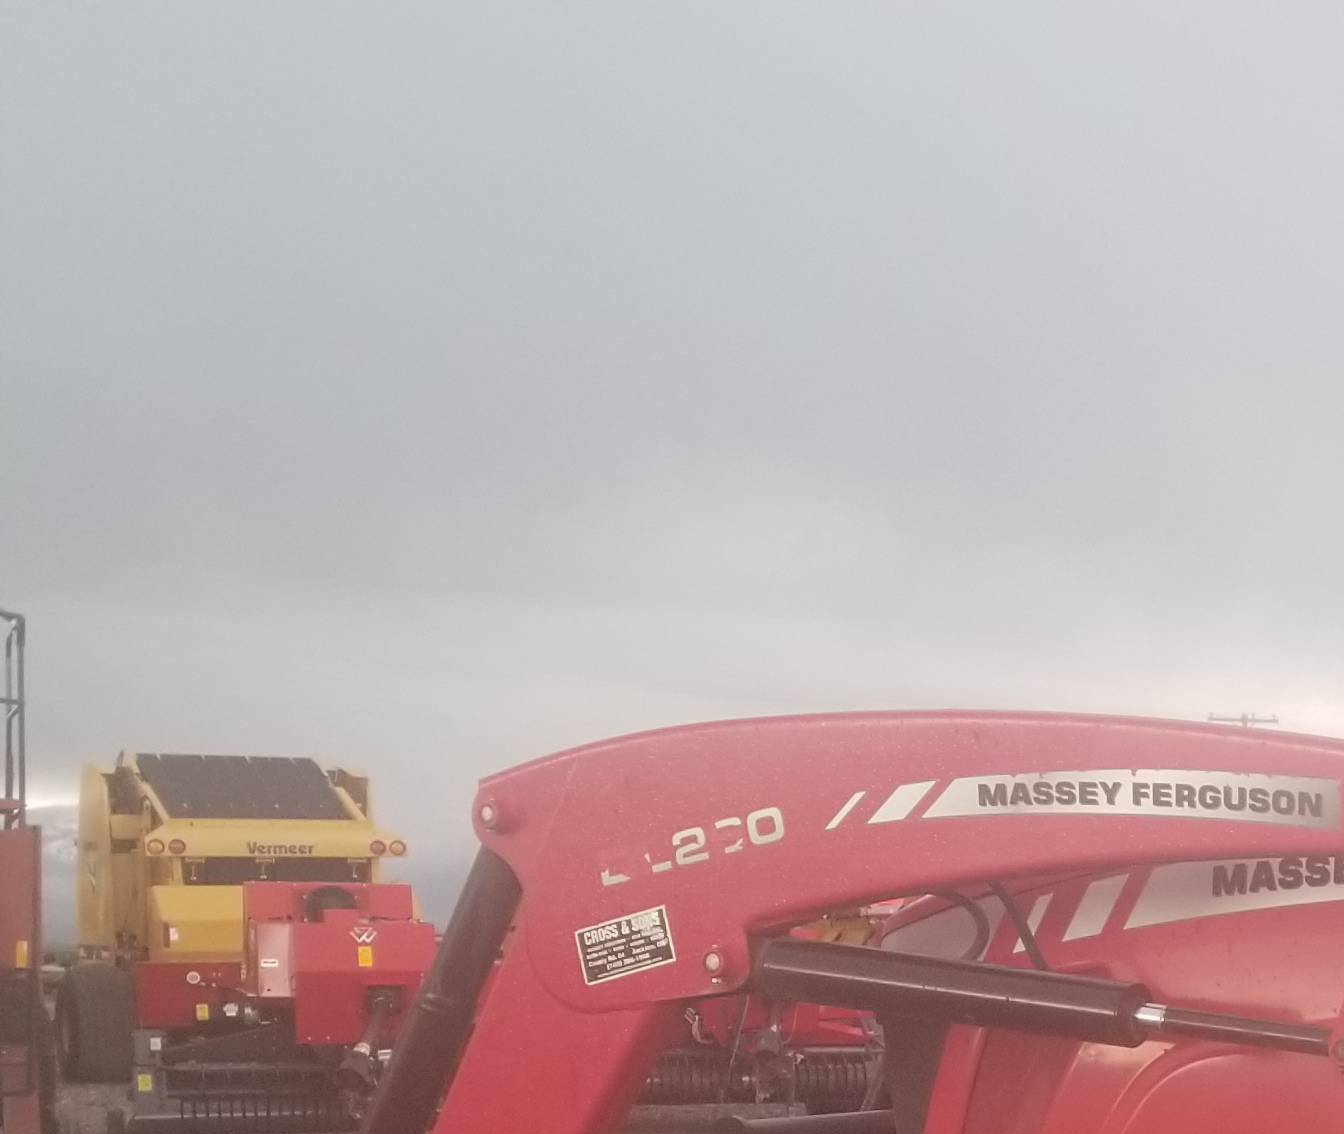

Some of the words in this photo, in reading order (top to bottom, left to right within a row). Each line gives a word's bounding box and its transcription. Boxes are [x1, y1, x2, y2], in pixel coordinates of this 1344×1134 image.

[977, 781, 1122, 807] MASSEY
[1131, 782, 1323, 818] FERGUSON
[246, 841, 315, 855] Vermeer
[583, 923, 619, 946] CROSS
[621, 920, 630, 935] &
[631, 910, 660, 932] SONS
